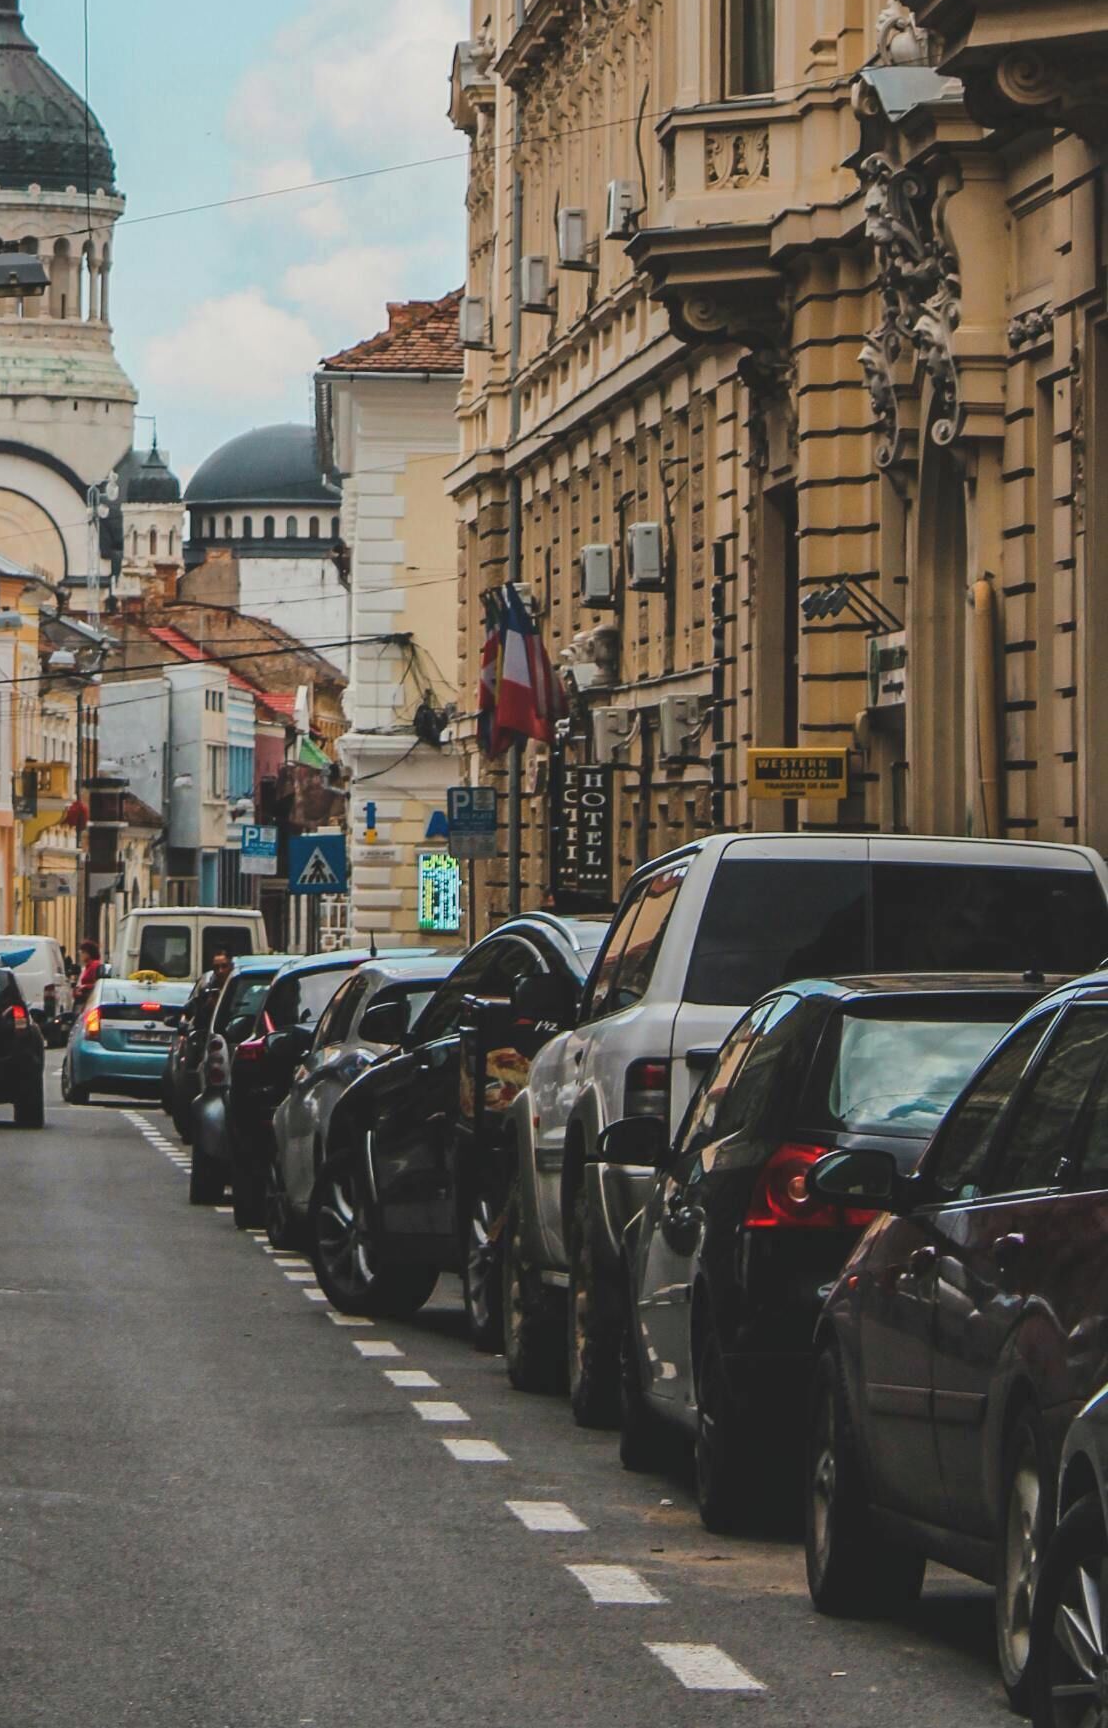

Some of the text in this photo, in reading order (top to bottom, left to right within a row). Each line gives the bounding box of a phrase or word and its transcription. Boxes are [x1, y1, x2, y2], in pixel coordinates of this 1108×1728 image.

[758, 759, 828, 768] WESTERN
[780, 769, 828, 778] UNION
[453, 790, 470, 819] P
[582, 774, 605, 865] HOTEL
[245, 827, 259, 847] P
